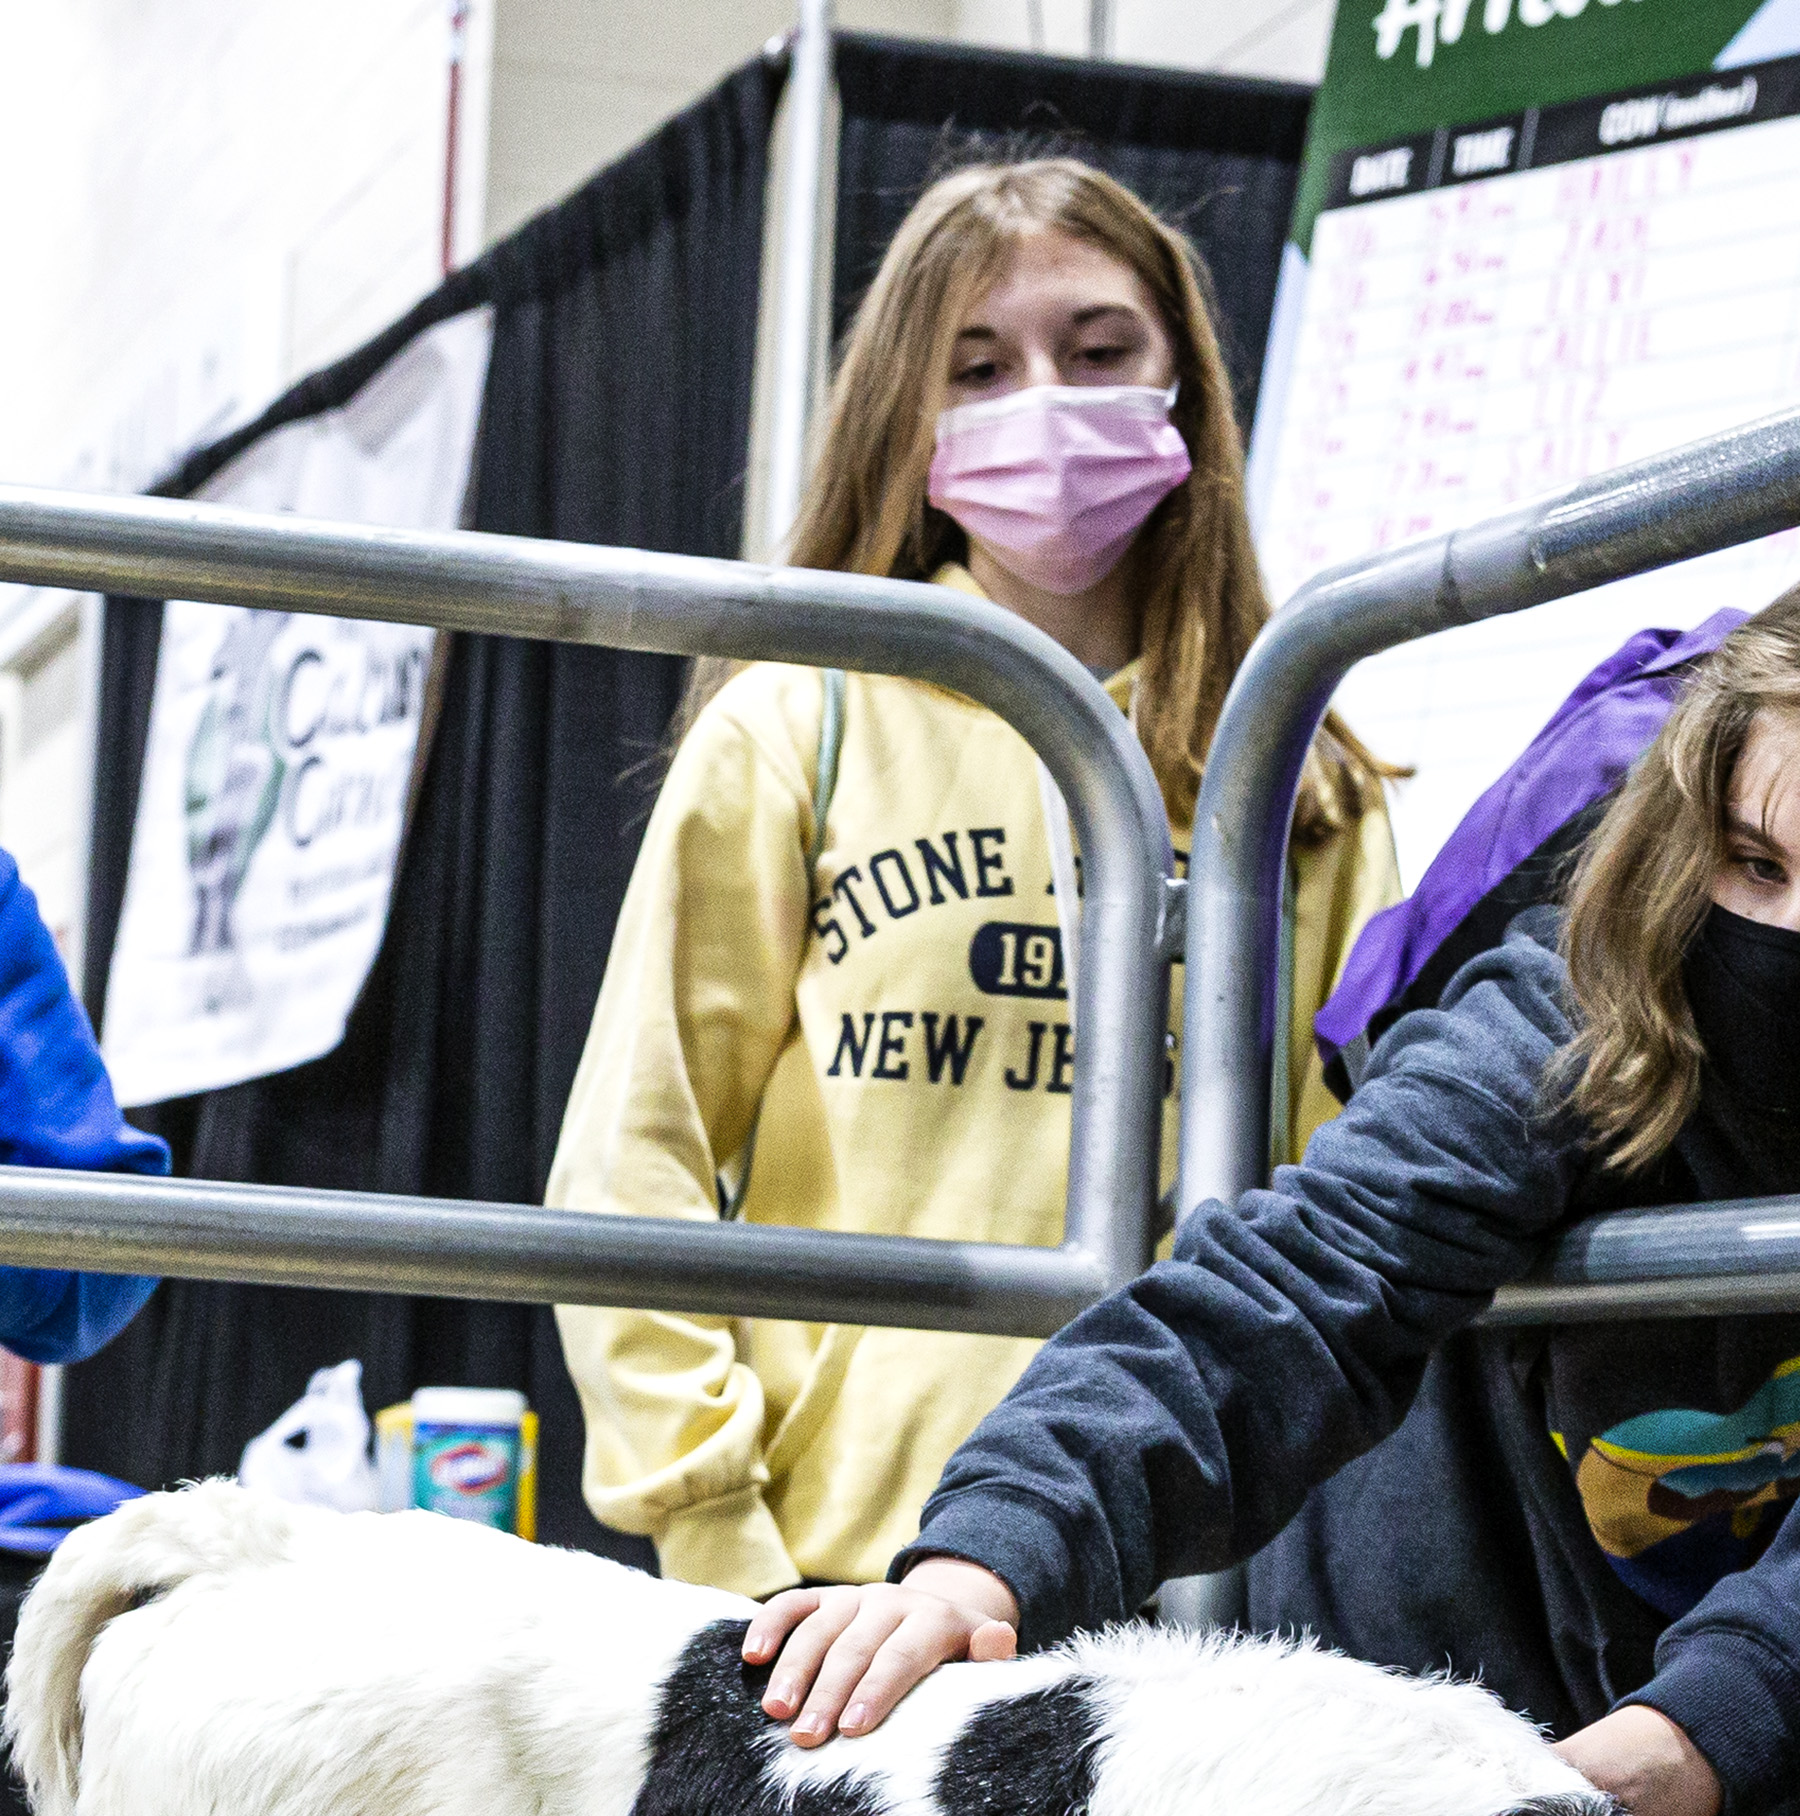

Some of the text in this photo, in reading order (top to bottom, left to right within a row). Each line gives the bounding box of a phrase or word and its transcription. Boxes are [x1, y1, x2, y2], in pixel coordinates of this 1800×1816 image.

[811, 828, 1014, 965] STONE
[998, 933, 1067, 988] 19
[827, 1012, 985, 1085] NEW
